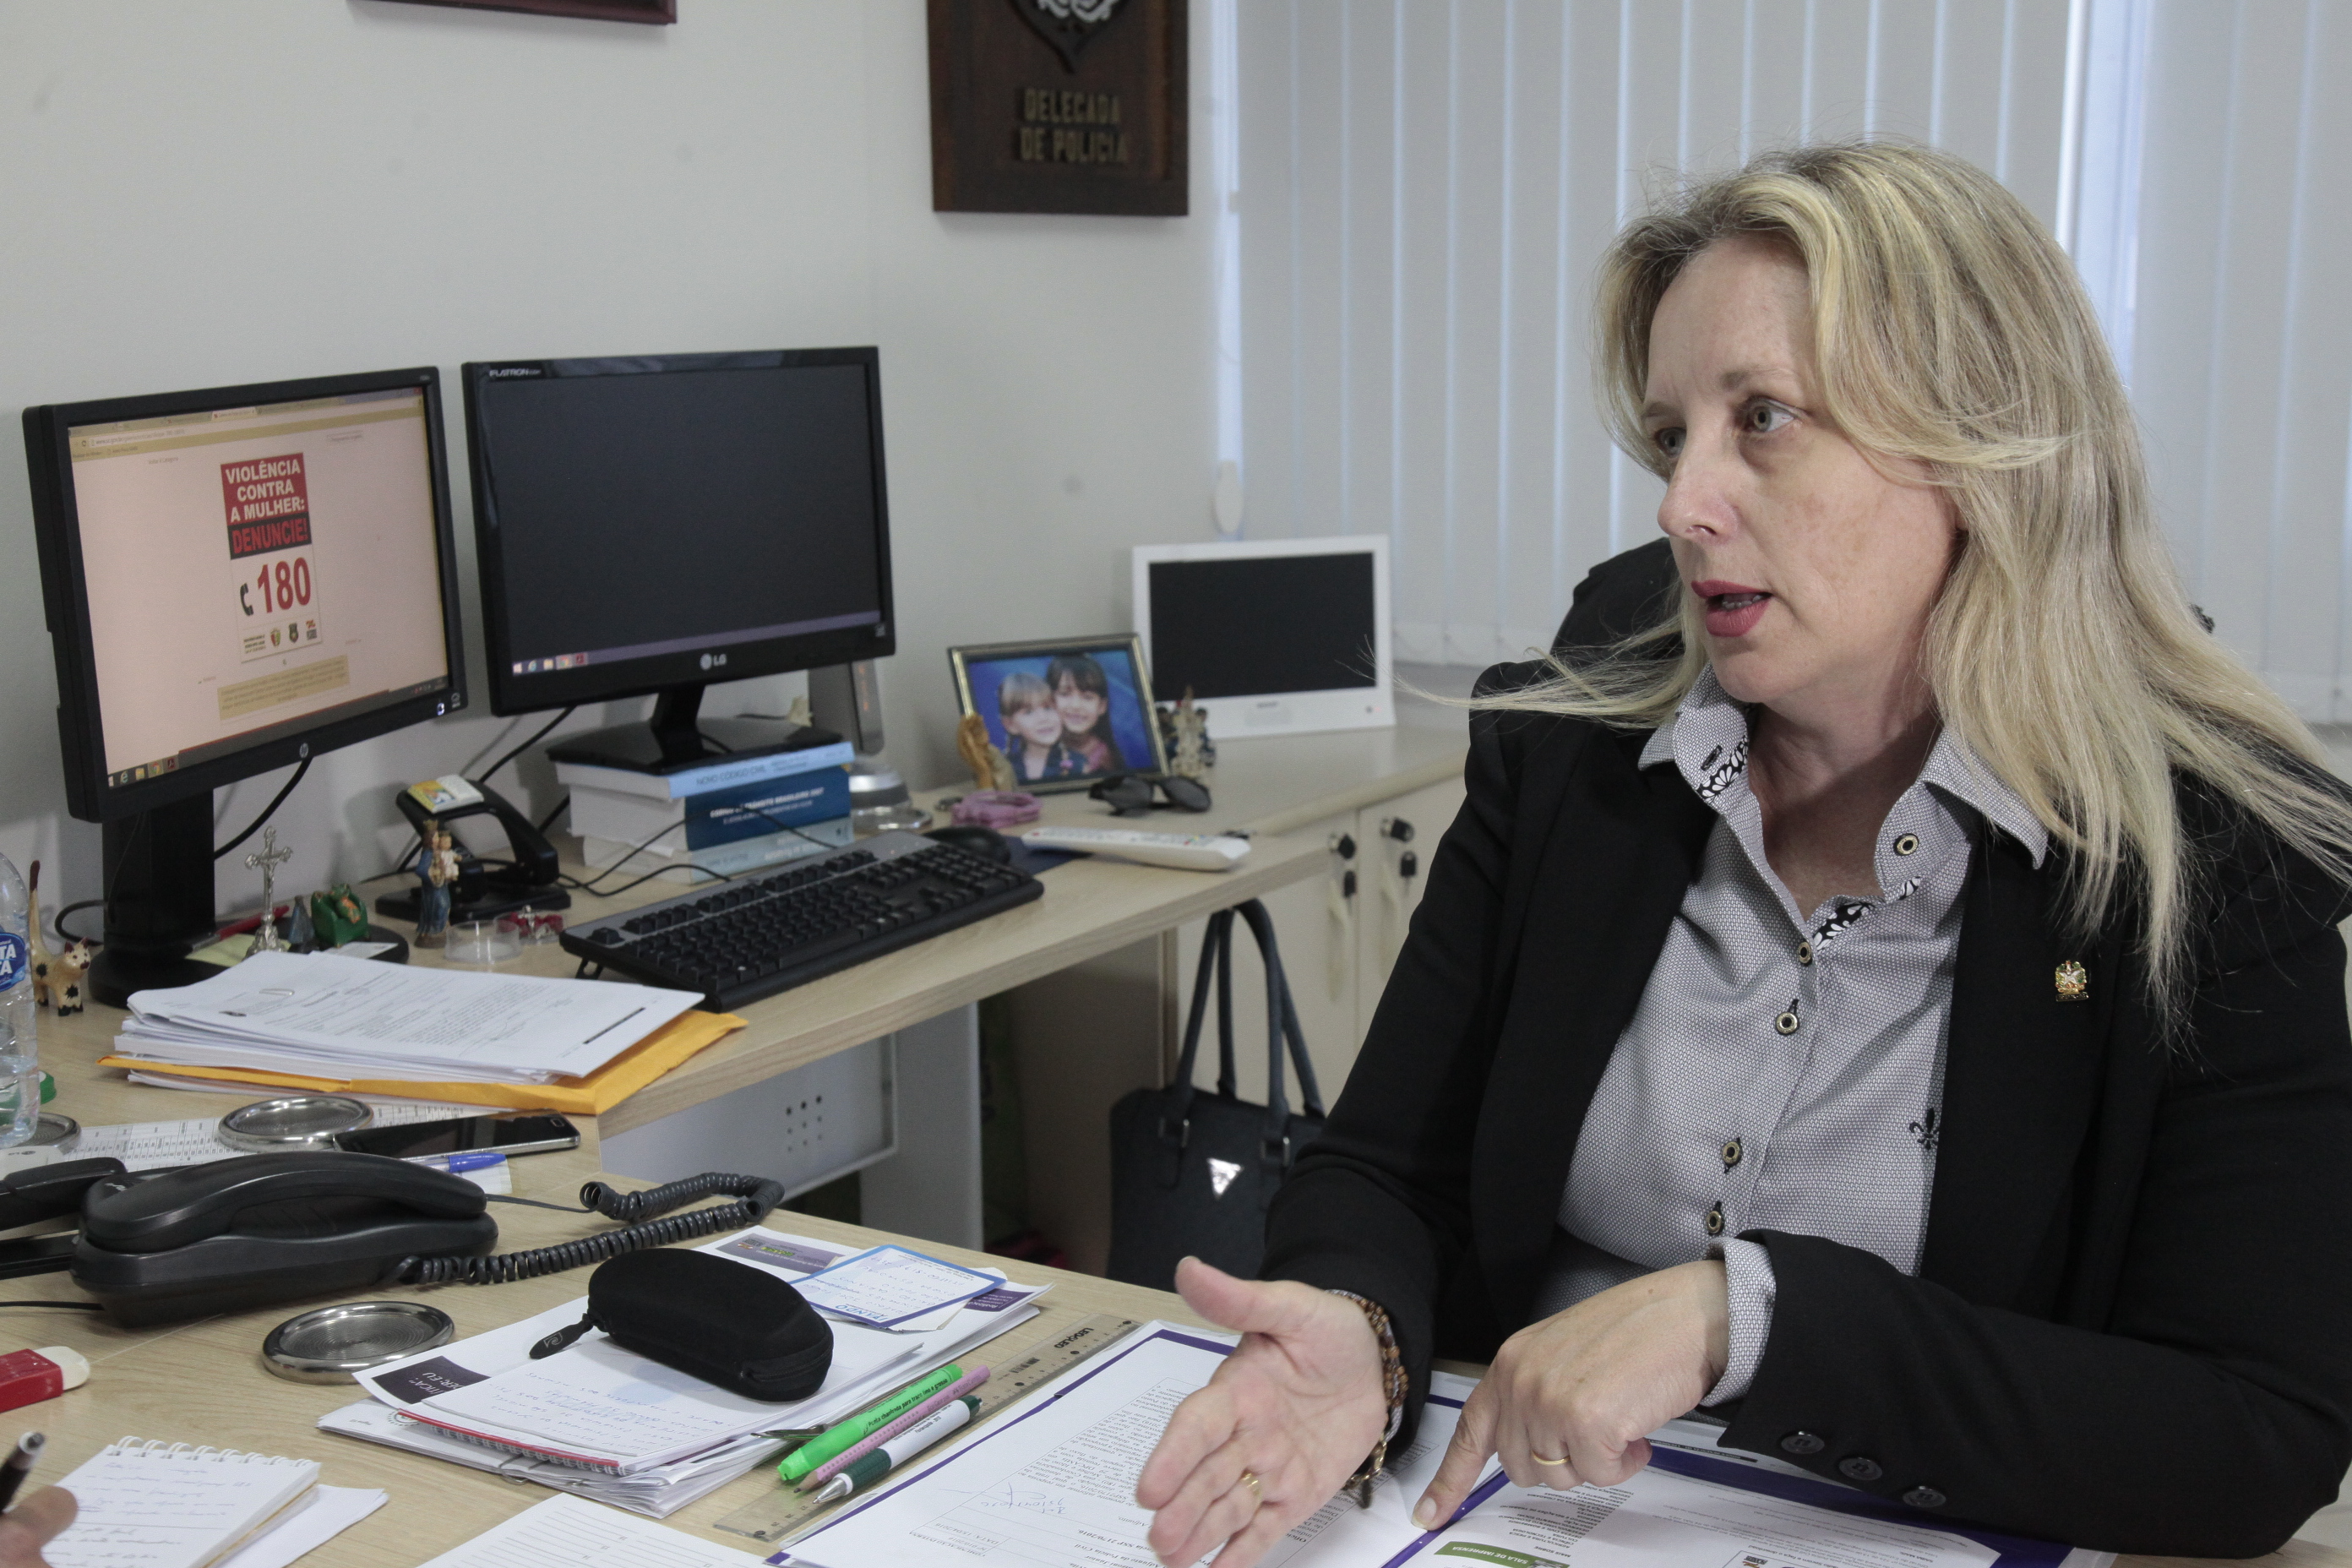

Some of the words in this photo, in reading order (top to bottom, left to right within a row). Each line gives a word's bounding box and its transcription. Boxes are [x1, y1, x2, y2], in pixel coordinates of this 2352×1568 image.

[1020, 128, 1045, 161] DE
[225, 459, 302, 484] VIOLÊNCIA
[237, 478, 295, 502] CONTRA
[231, 507, 241, 523] A
[243, 496, 305, 520] MULHER:
[232, 517, 308, 554] DENUNCIE!
[258, 557, 311, 613] 180
[713, 653, 727, 667] LG
[1452, 1547, 1494, 1555] IMPRENSA
